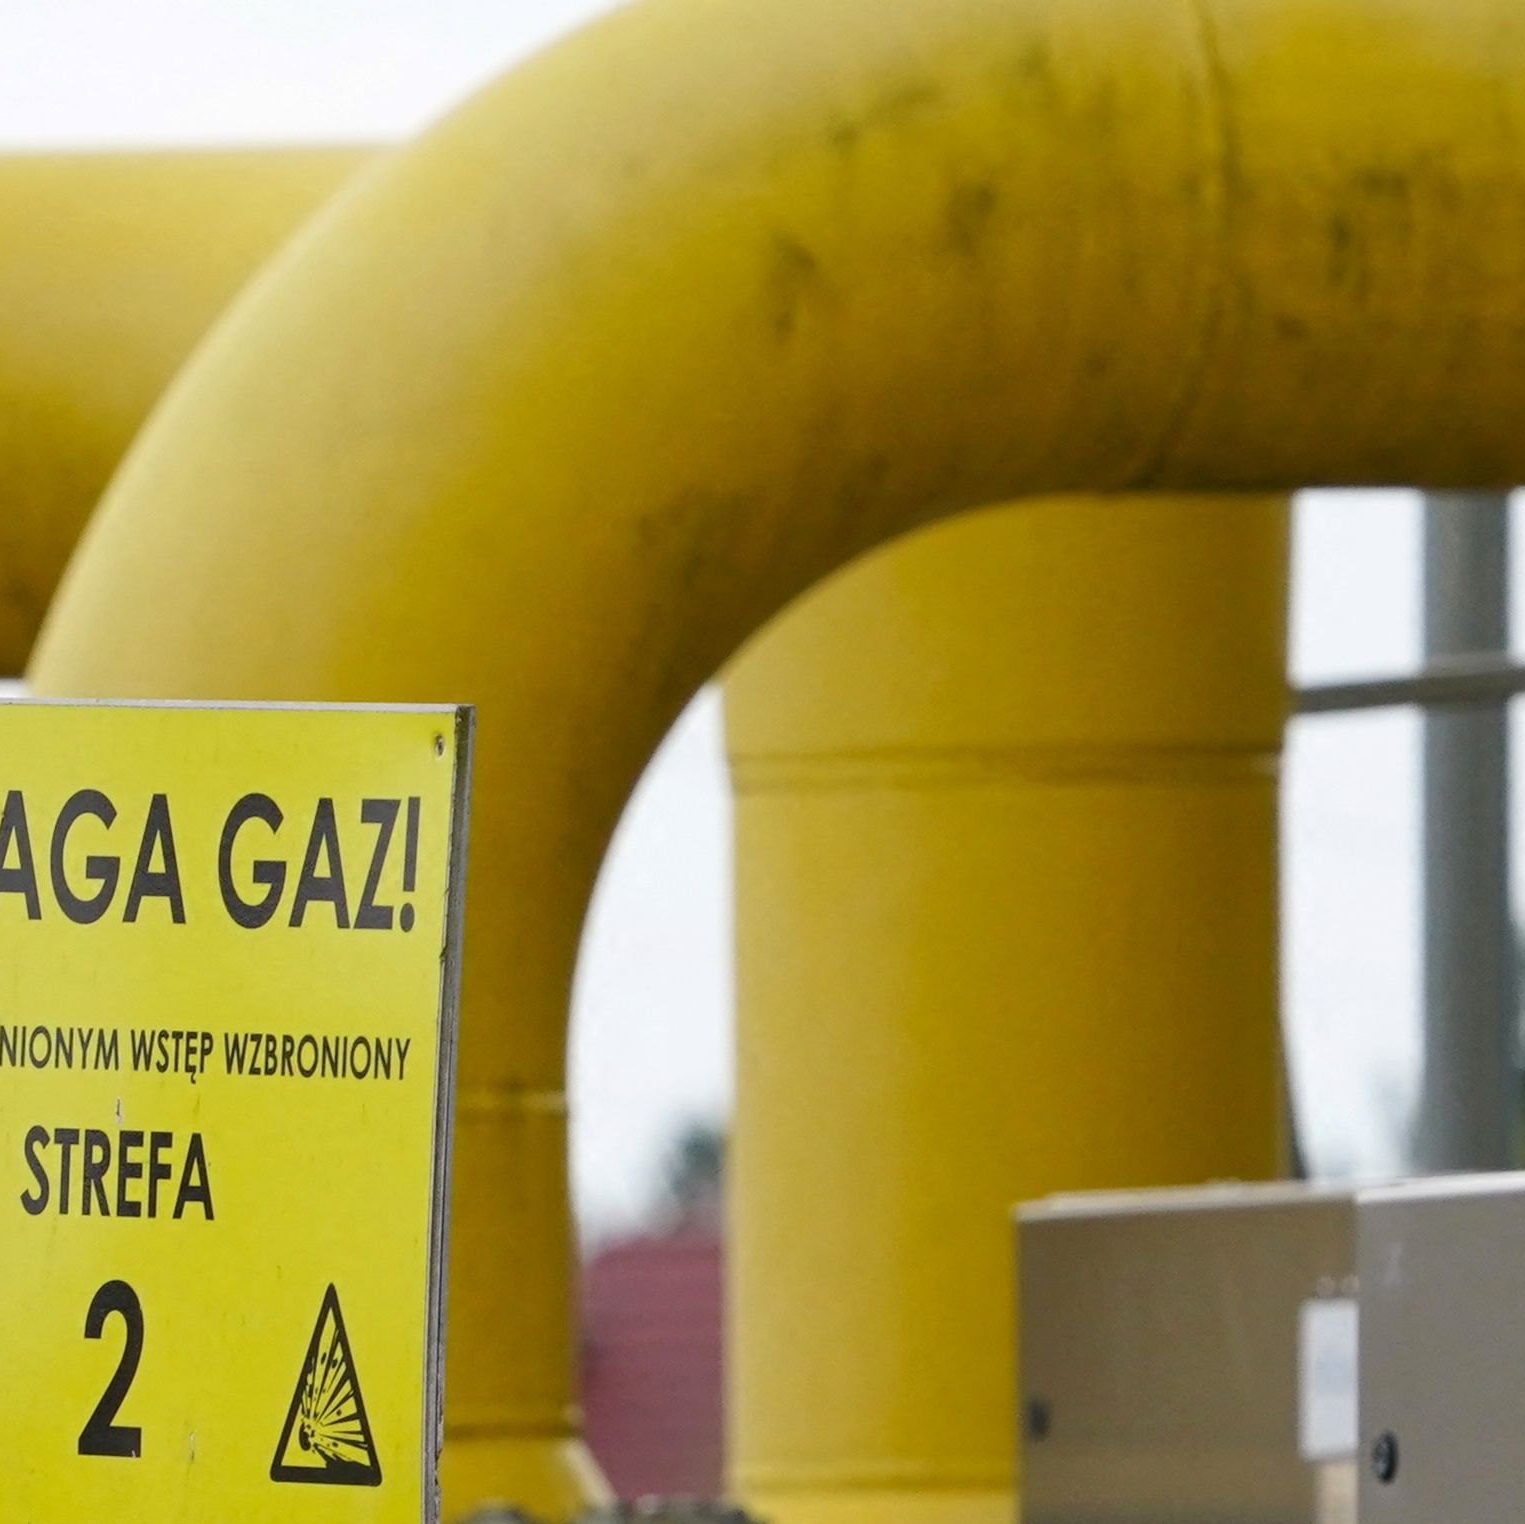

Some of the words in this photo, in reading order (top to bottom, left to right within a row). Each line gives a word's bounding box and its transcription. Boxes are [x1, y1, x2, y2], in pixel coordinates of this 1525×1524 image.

[217, 792, 421, 933] GAZ!
[130, 1029, 214, 1084] WSTĘP
[224, 1032, 411, 1081] WZBRONIONY
[19, 1125, 215, 1221] STREFA
[77, 1279, 145, 1458] 2
